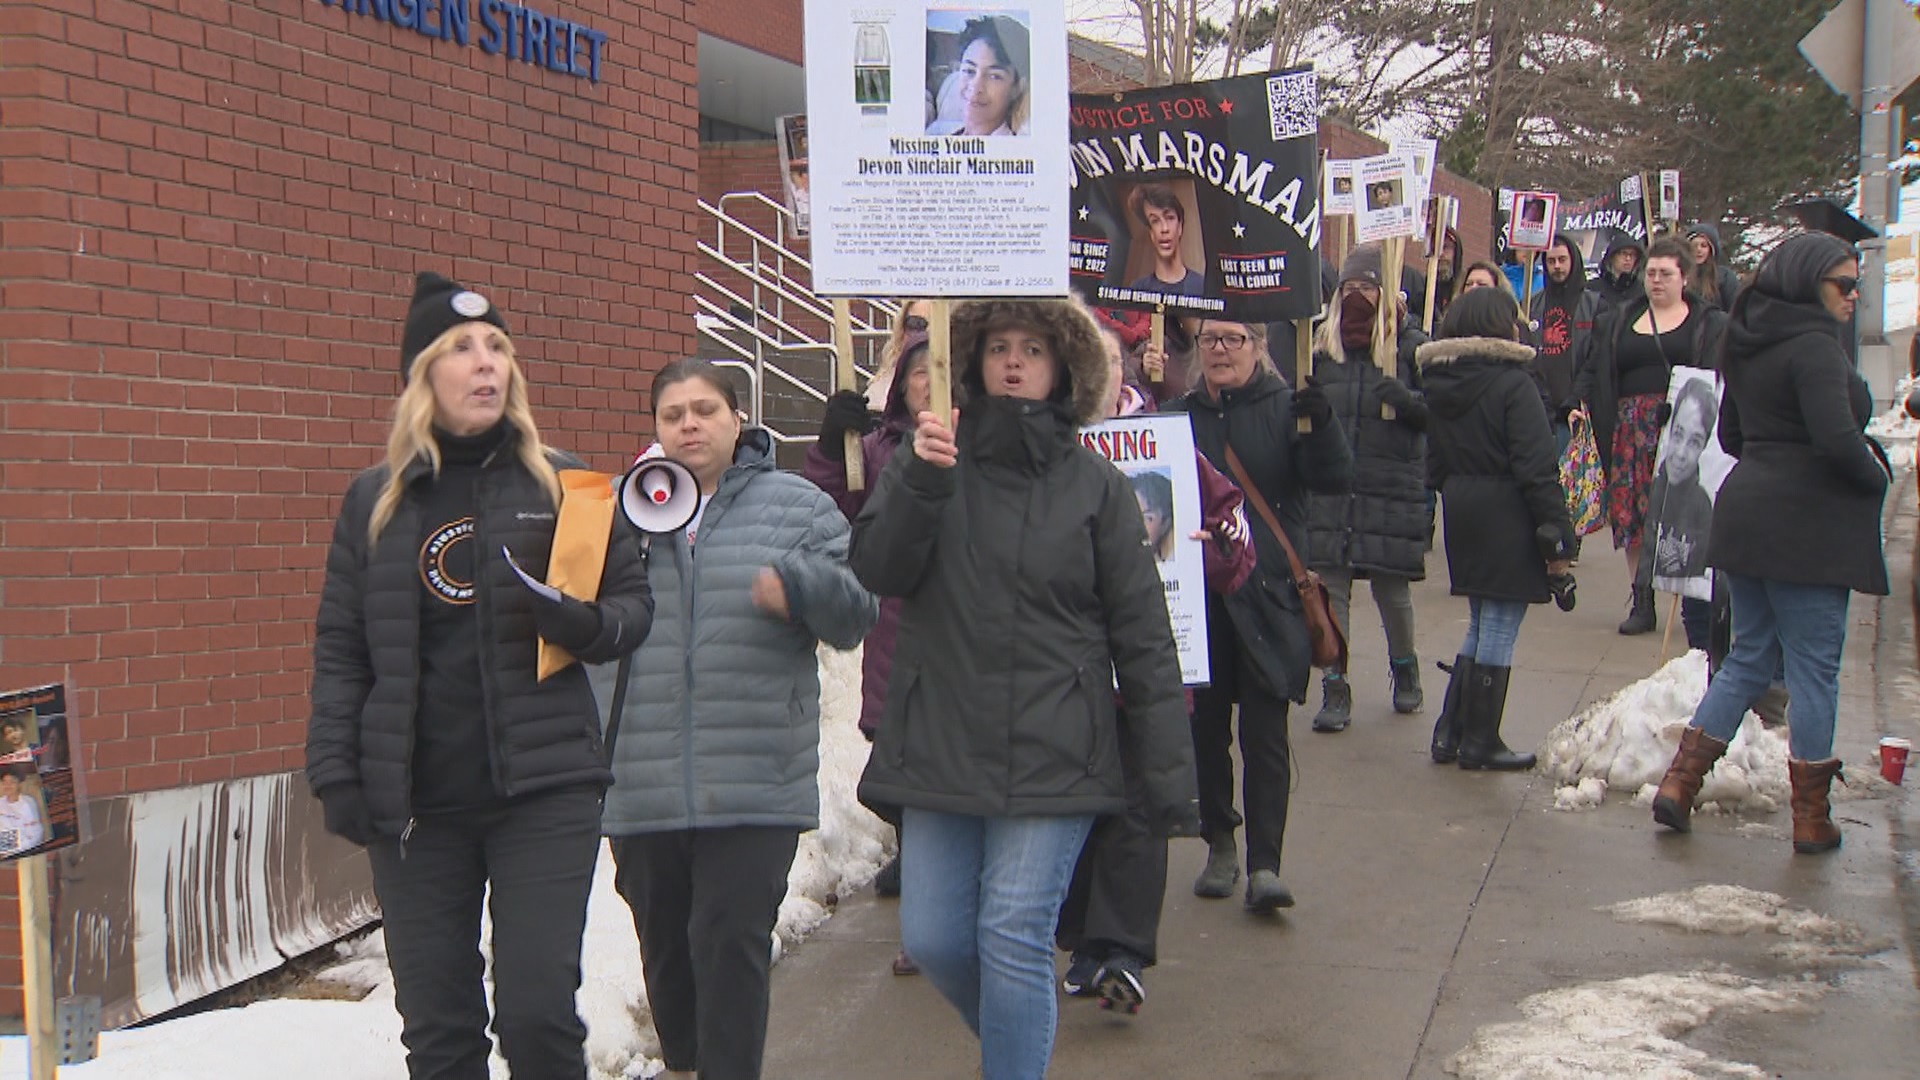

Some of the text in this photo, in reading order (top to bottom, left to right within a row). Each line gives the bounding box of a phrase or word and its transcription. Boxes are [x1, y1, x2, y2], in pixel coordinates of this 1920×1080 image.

[479, 0, 607, 83] STREET
[1070, 98, 1213, 128] USTICE FOR
[890, 137, 985, 155] Missing Youth
[858, 157, 1034, 175] Devon Sinclair Marsman
[1113, 130, 1320, 251] MARSMAN
[1563, 209, 1647, 241] MARSMAN
[1083, 242, 1109, 259] SINCE
[1085, 259, 1106, 272] 2022
[1220, 256, 1286, 273] LAST SEEN ON
[1246, 272, 1281, 289] COURT
[1132, 290, 1163, 304] REWARD
[1163, 293, 1178, 306] FOR
[1178, 295, 1226, 312] INFORMATION
